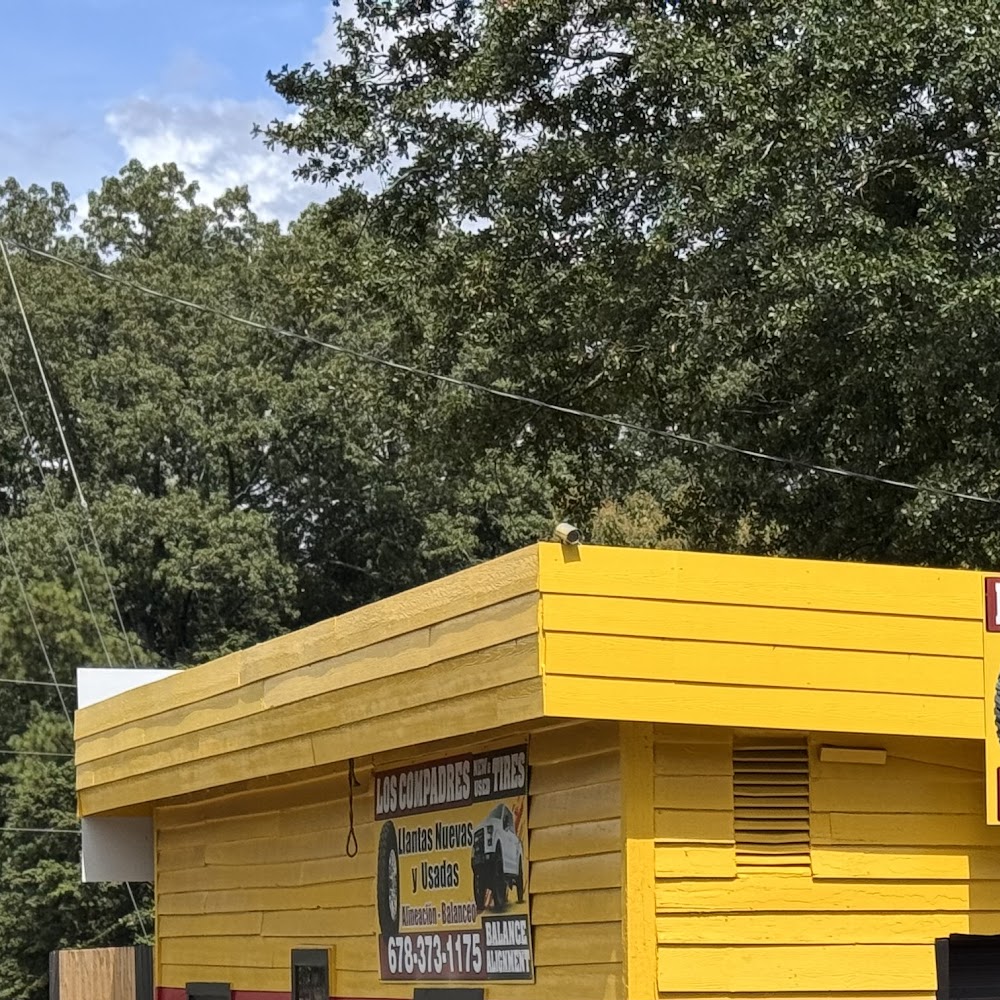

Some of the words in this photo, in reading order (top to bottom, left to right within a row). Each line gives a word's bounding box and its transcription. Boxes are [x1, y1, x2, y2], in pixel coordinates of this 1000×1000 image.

[473, 758, 488, 777] NEW
[492, 752, 526, 792] TIRES
[376, 775, 398, 815] LOS
[399, 760, 471, 811] COMPADRES
[474, 778, 491, 798] USED
[398, 825, 432, 854] Llantas
[435, 822, 473, 850] Nuevas
[411, 867, 418, 893] y
[421, 860, 459, 890] Usadas
[402, 903, 437, 926] Alineación
[441, 902, 476, 924] Balanceo
[485, 920, 527, 946] BALANCE
[388, 933, 482, 974] 678-373-1175
[486, 949, 530, 973] ALIGNMENT
